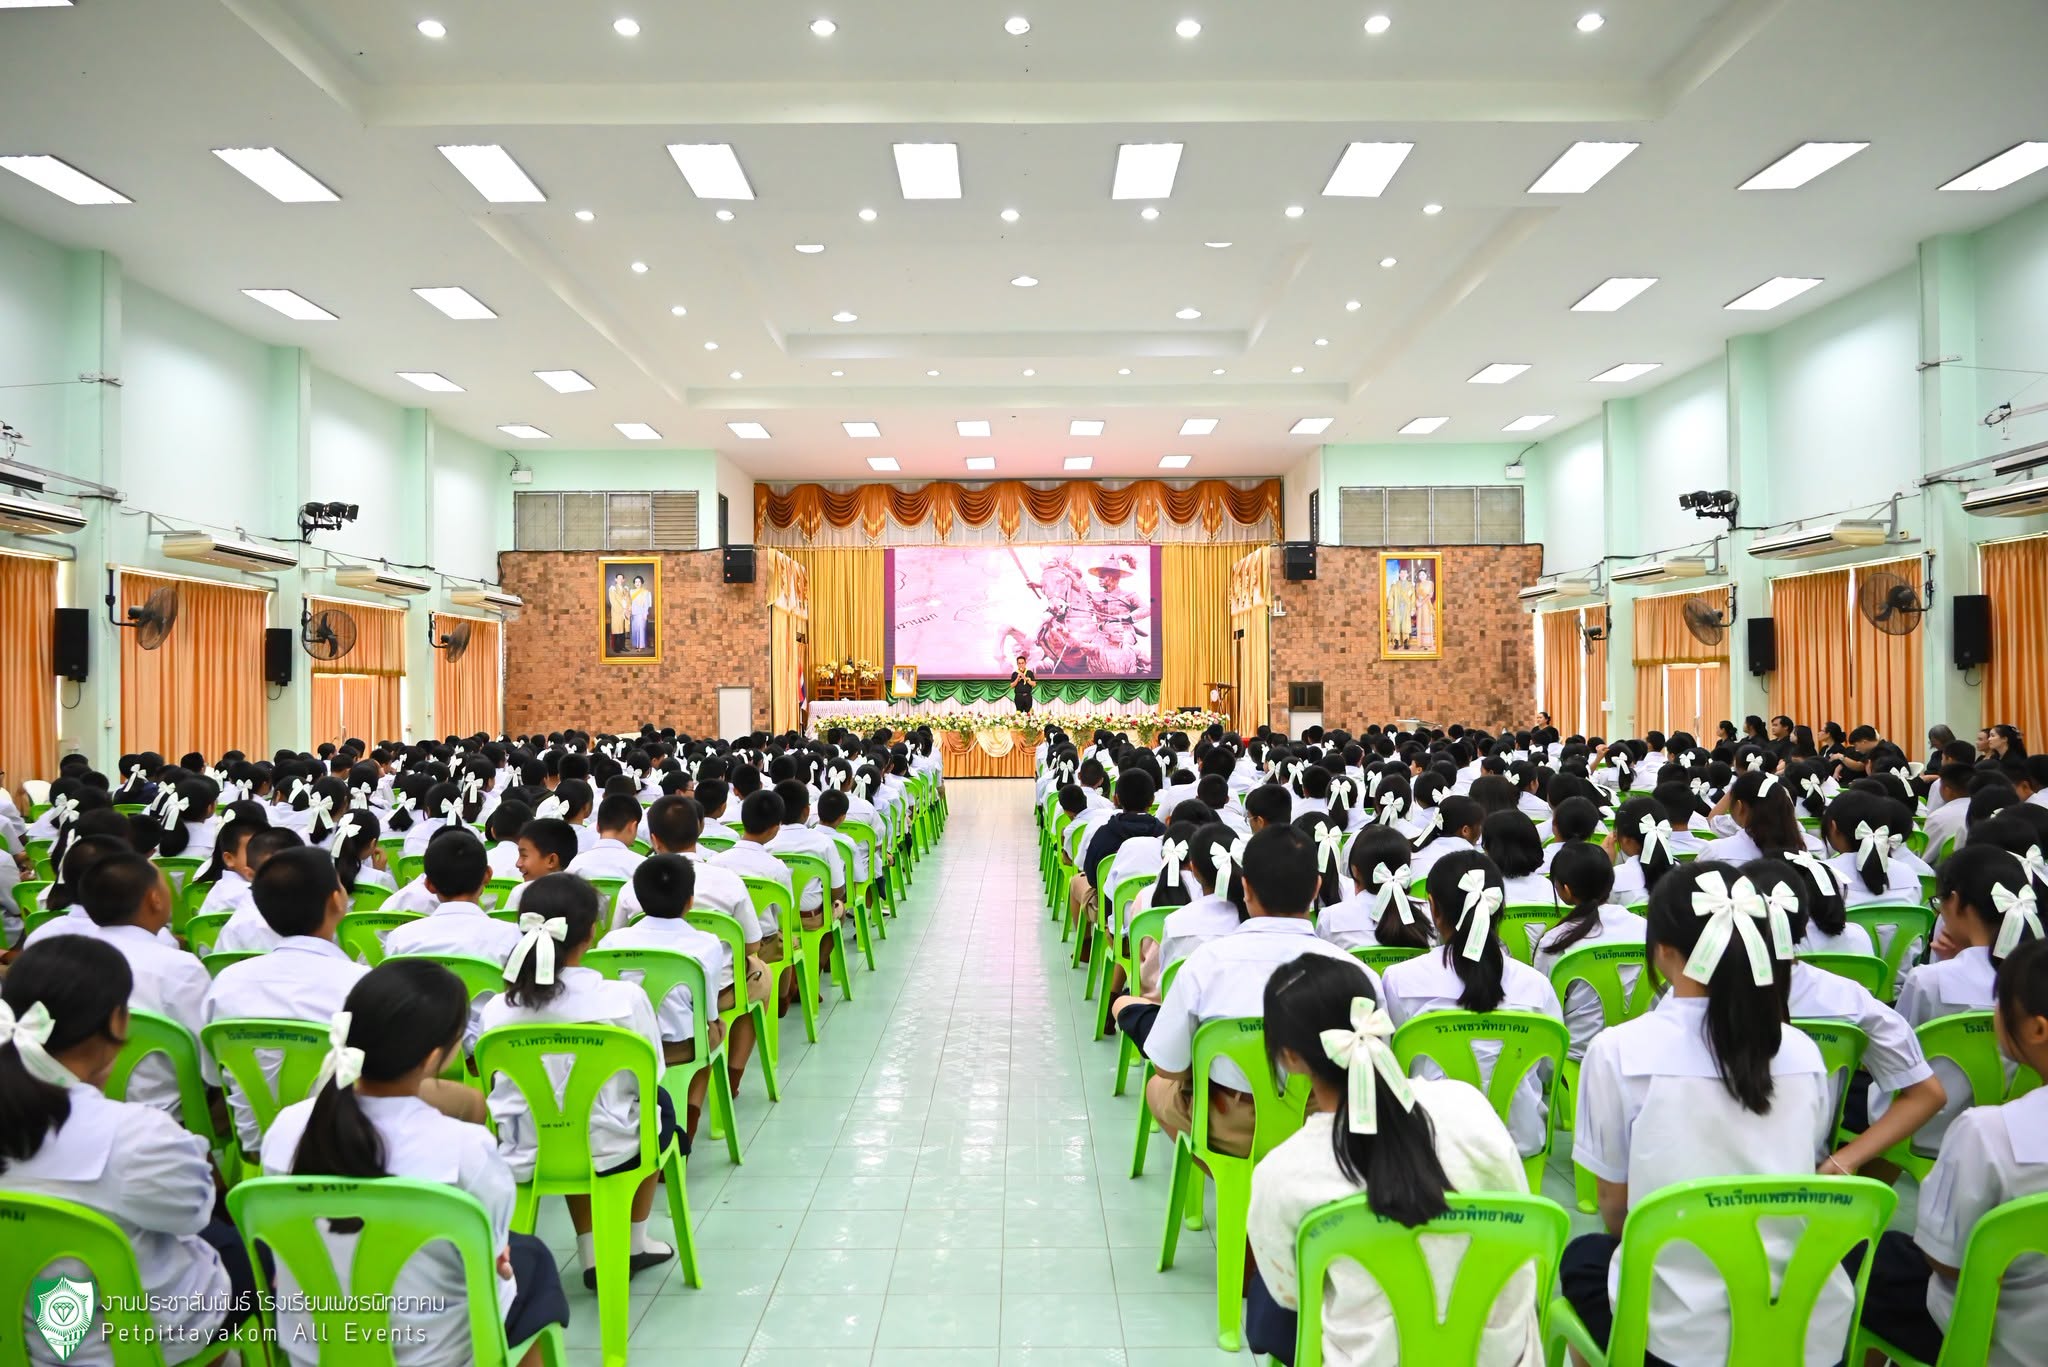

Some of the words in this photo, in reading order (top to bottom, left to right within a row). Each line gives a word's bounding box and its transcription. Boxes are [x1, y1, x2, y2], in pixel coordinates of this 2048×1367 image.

[1704, 1187, 1853, 1208] โรงเรียนเพชรพิทยาคม
